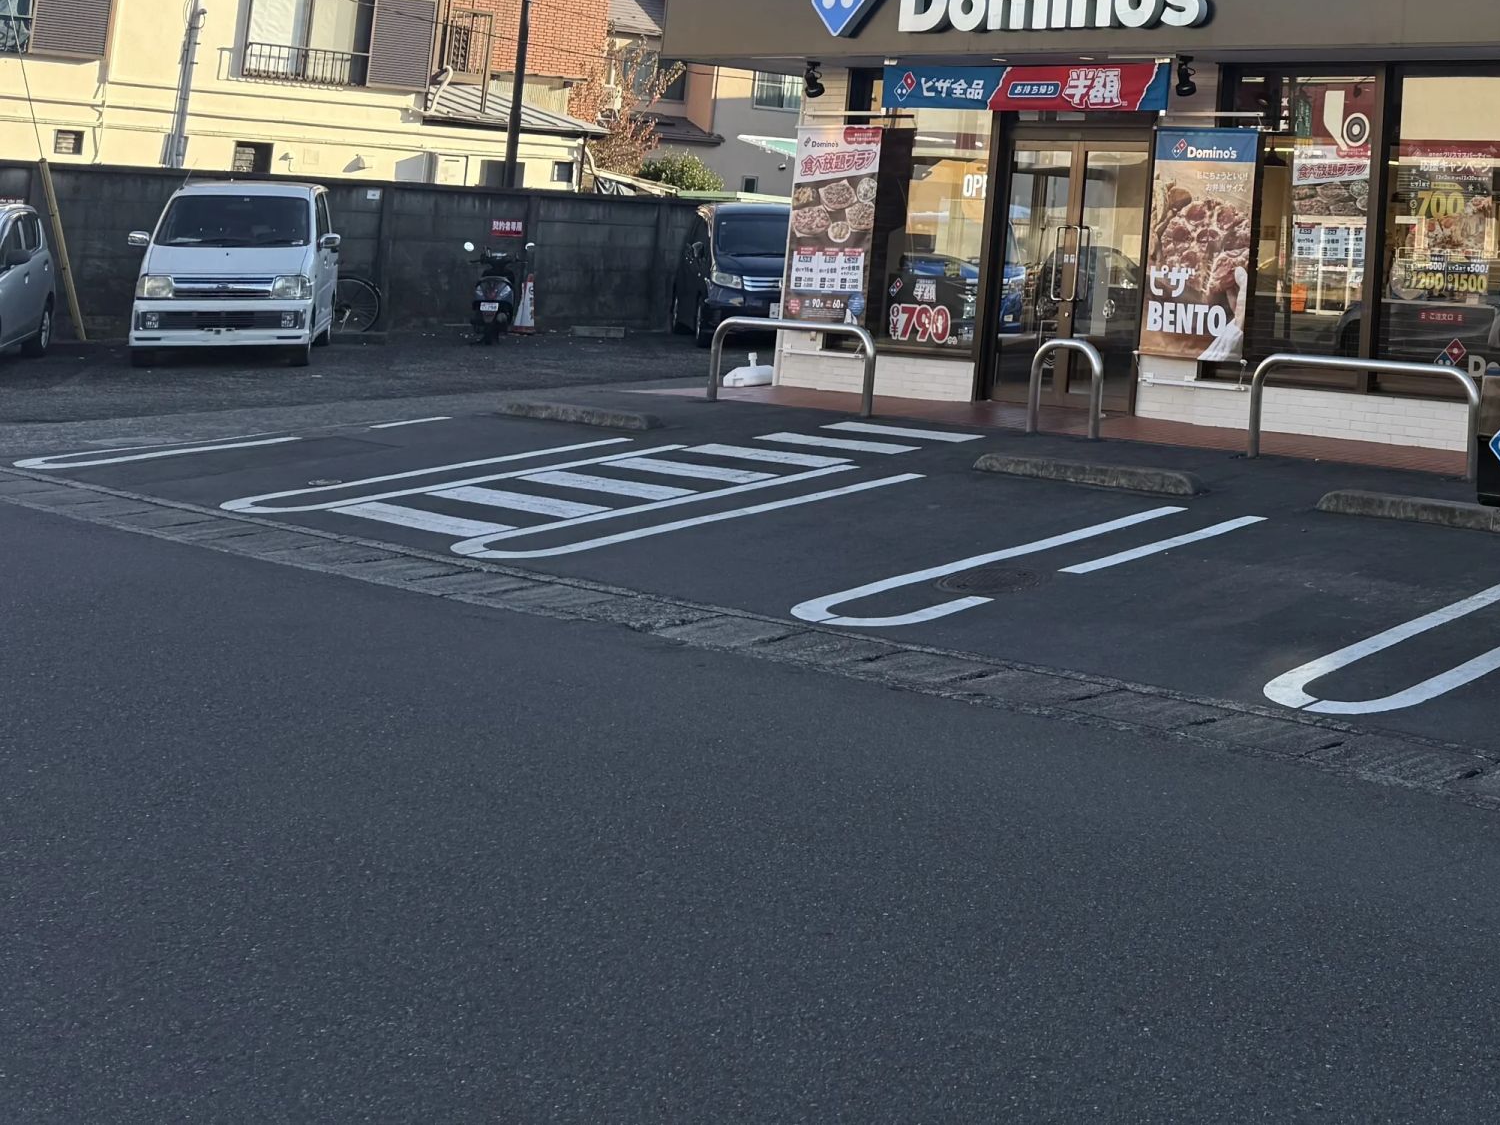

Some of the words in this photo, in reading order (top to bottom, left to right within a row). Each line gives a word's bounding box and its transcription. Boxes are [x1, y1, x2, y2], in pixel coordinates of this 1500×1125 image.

[920, 77, 985, 101] ピザ全品
[1062, 67, 1122, 110] 半額
[811, 139, 839, 149] Domino's
[1187, 146, 1238, 159] Domino's
[800, 149, 877, 177] 食べ放題プラン
[1150, 264, 1196, 298] ピザ
[1146, 300, 1227, 337] BENTO
